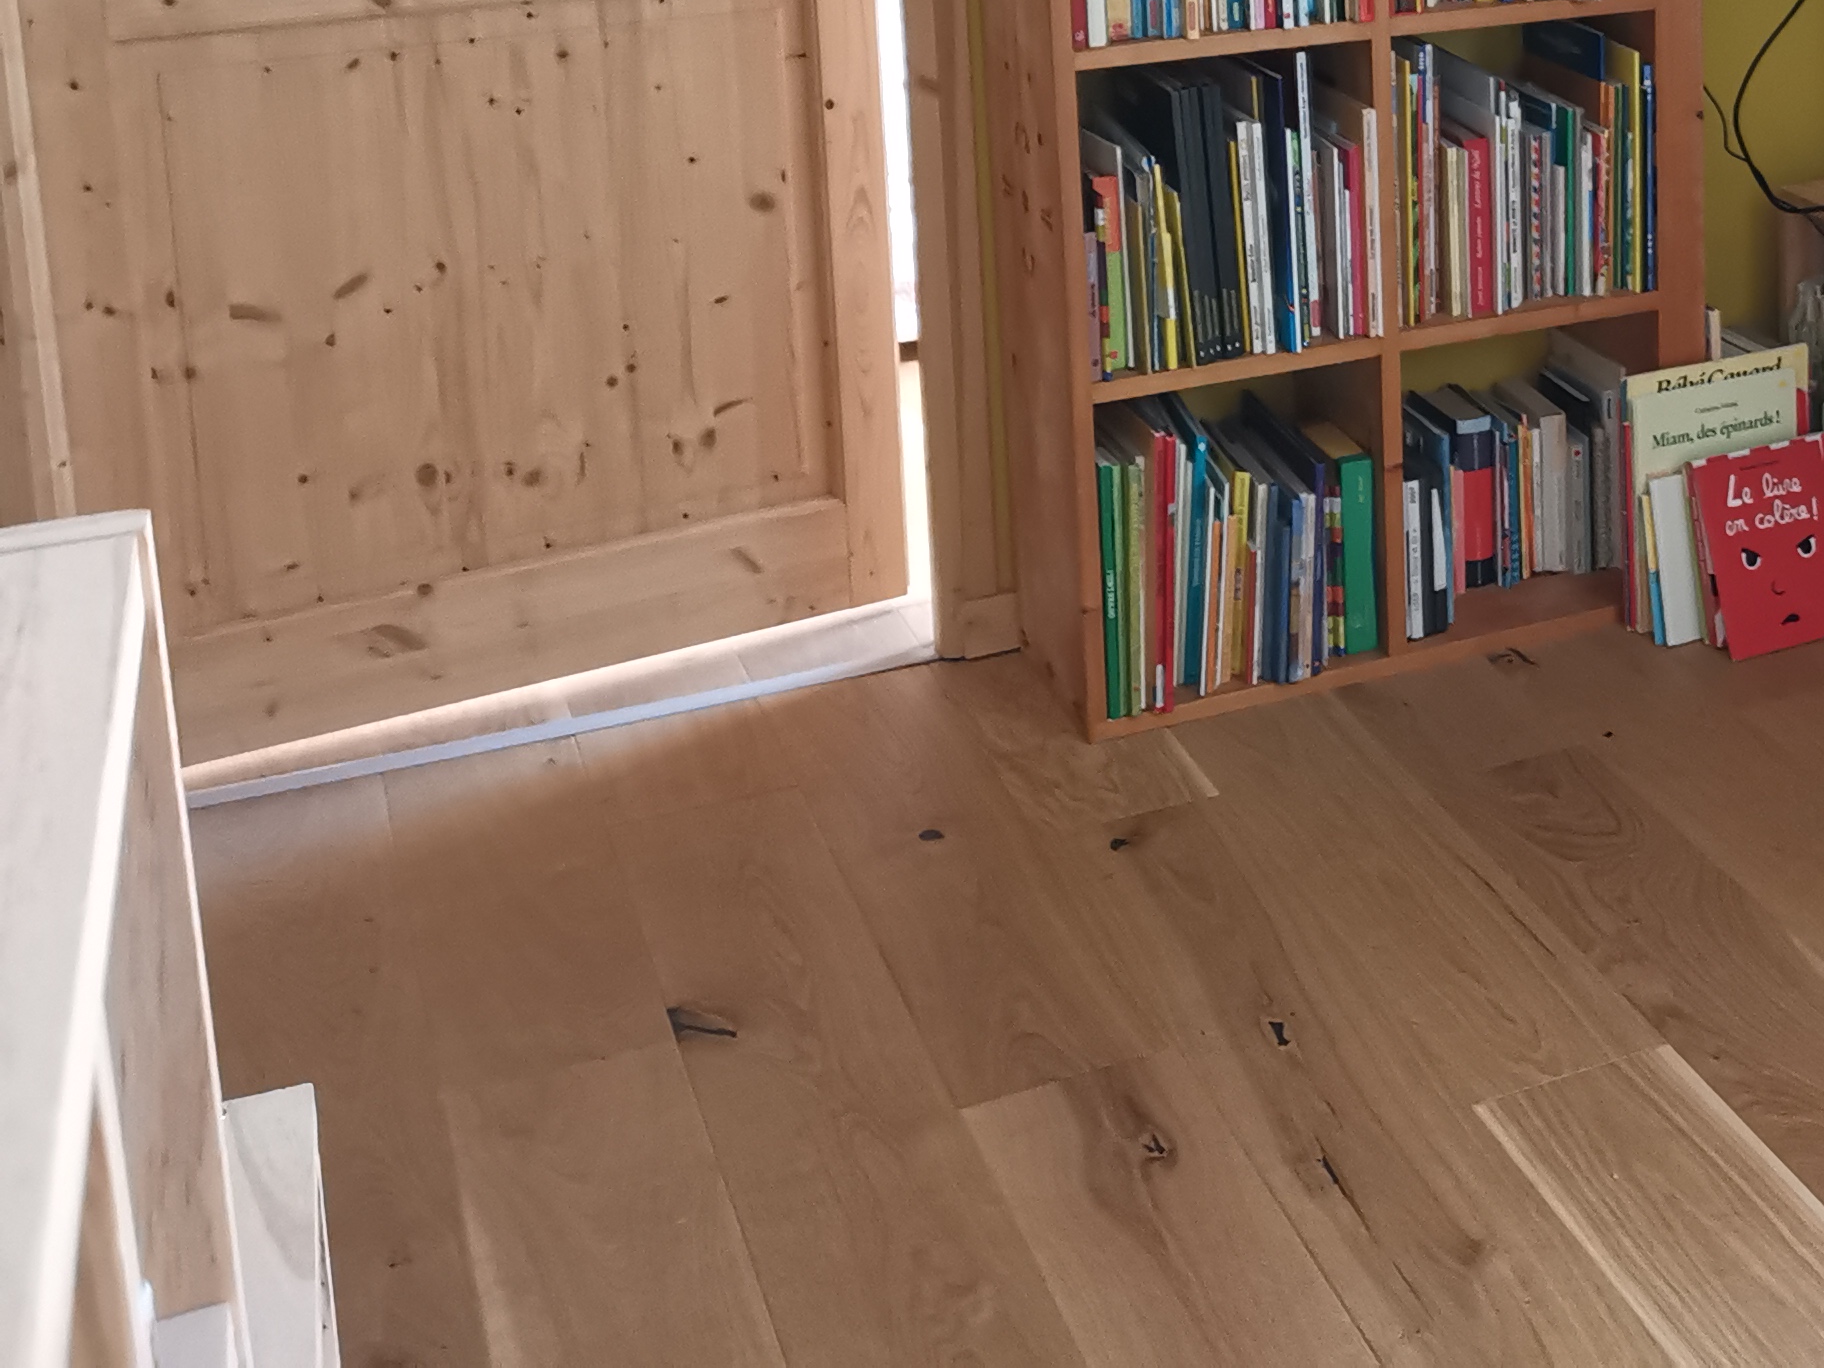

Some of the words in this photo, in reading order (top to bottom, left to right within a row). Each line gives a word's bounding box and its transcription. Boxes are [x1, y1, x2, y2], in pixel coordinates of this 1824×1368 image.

[1652, 430, 1695, 450] Miam,
[1696, 422, 1718, 441] des
[1726, 474, 1754, 508] Le
[1761, 472, 1803, 500] livre
[1725, 511, 1749, 537] en
